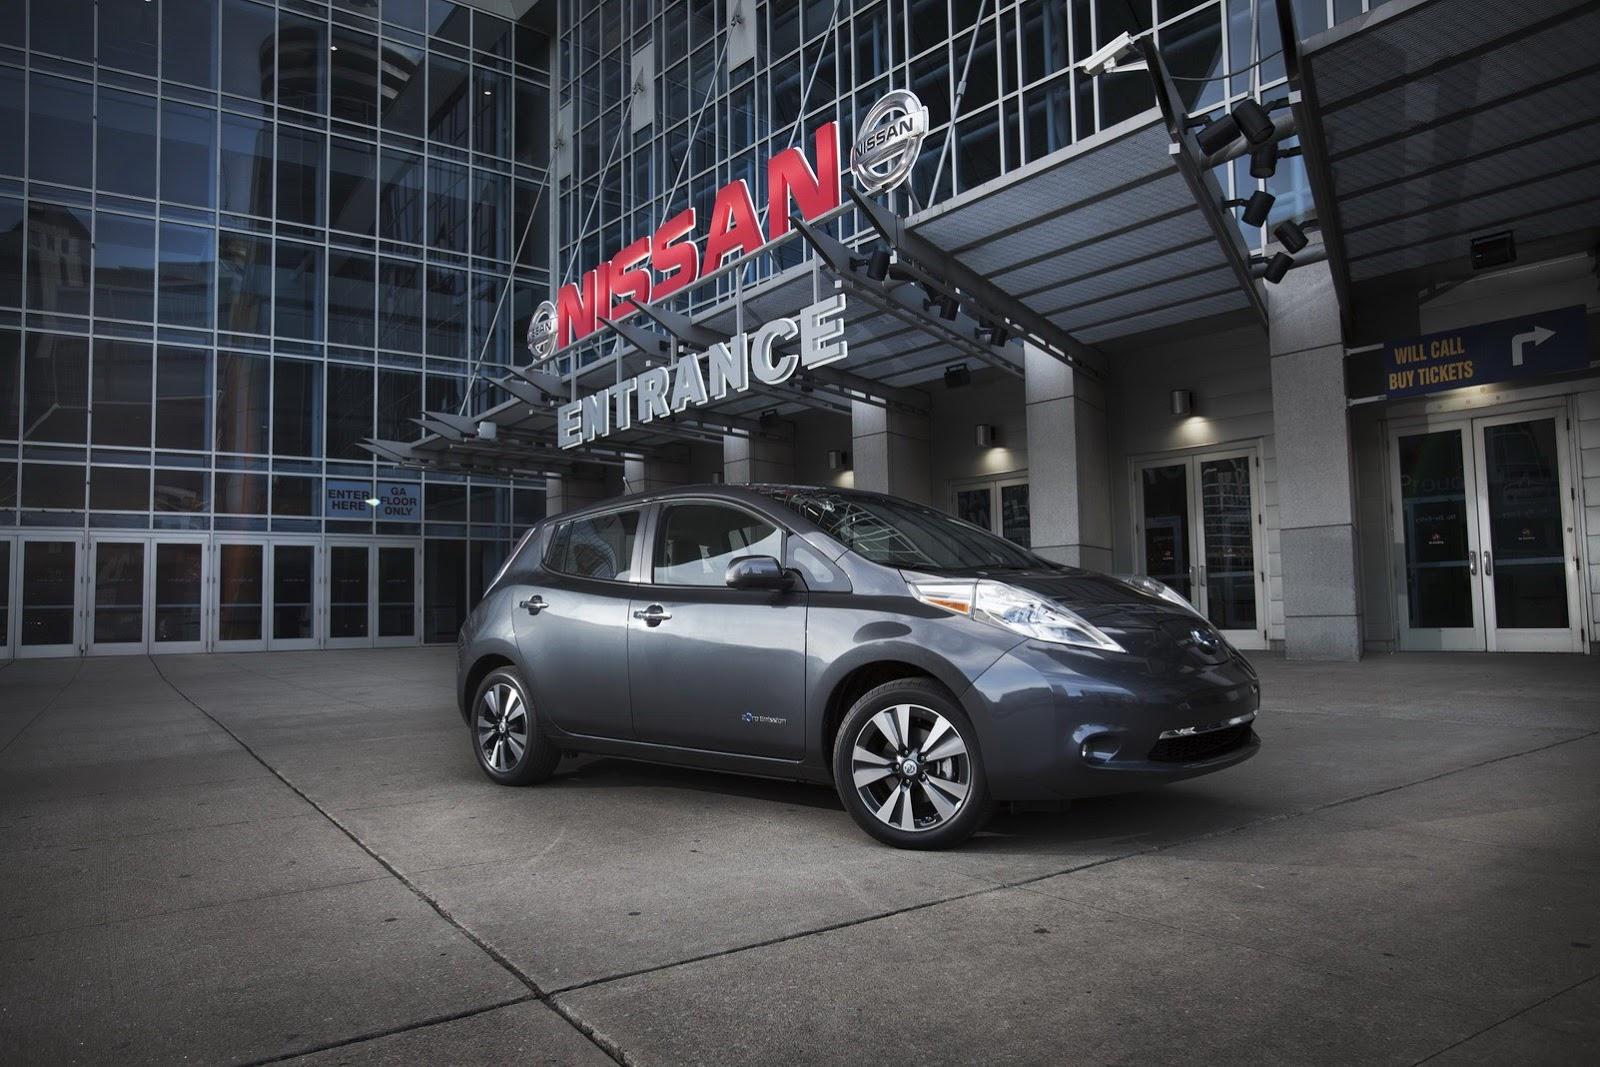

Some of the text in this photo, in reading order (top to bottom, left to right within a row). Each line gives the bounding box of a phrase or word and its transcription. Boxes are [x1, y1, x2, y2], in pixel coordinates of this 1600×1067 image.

[855, 117, 913, 157] NISSAN
[557, 121, 840, 350] NISSAN
[1394, 337, 1465, 365] WILL CALL
[557, 293, 848, 449] ENTRANCE
[1388, 360, 1474, 390] BUY TICKETS
[328, 489, 370, 500] ENTER
[390, 486, 407, 496] GA
[332, 500, 366, 511] HERE
[380, 496, 417, 506] FLOOR
[384, 506, 413, 516] ONLY
